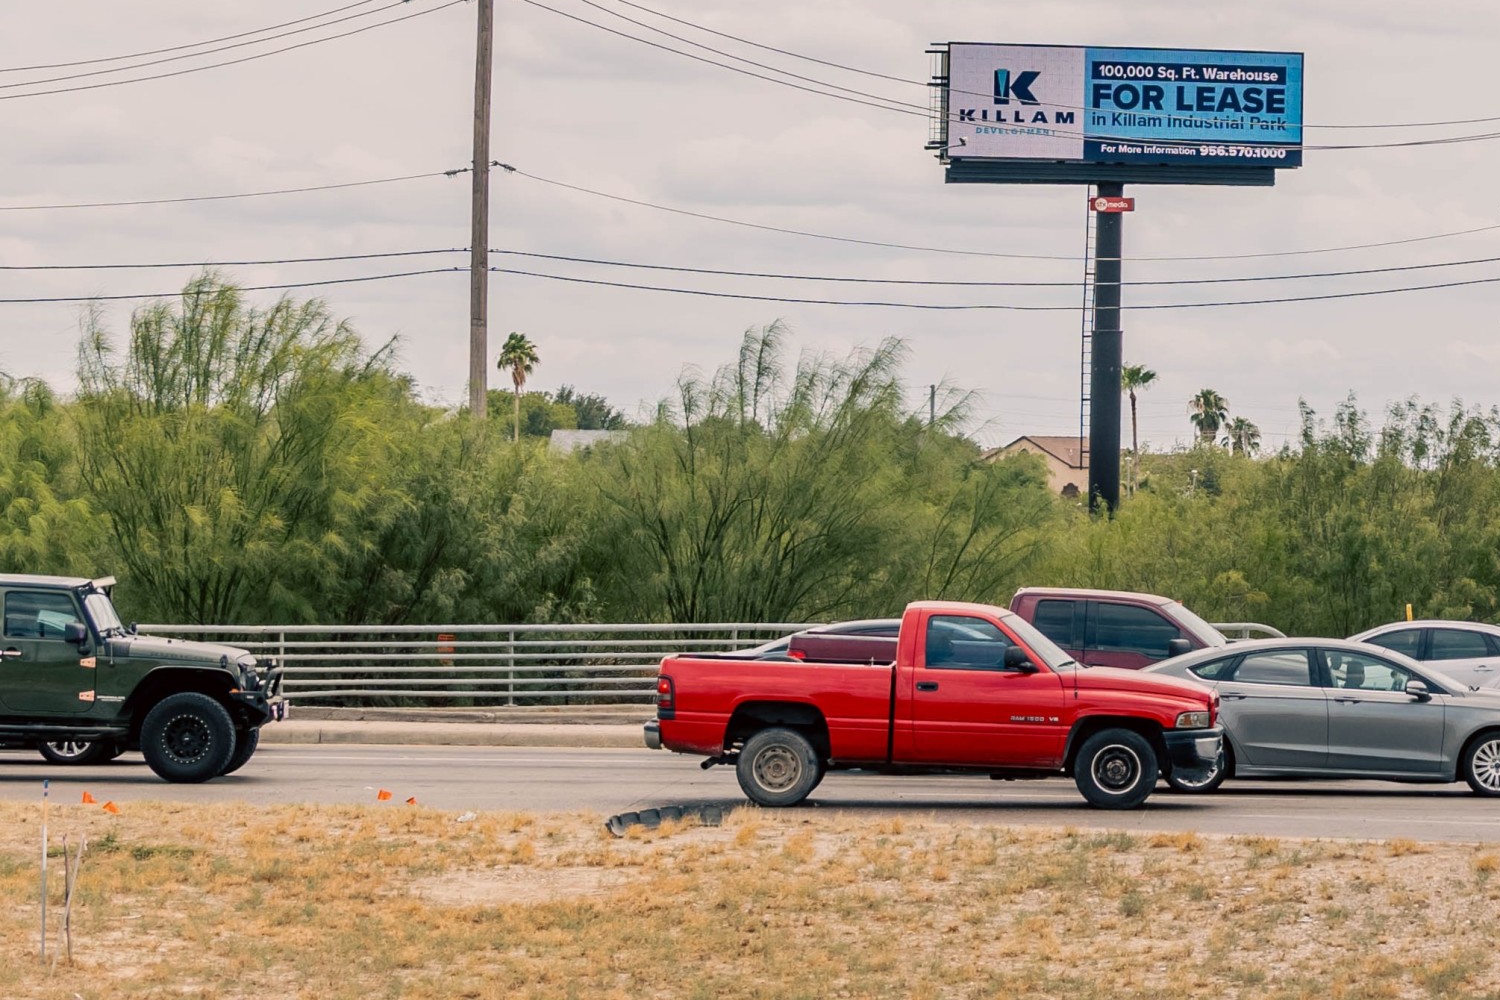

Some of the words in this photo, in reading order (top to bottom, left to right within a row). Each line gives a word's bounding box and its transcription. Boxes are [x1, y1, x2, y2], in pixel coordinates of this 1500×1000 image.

[1099, 65, 1154, 79] 100,000
[1157, 66, 1179, 81] Sq.
[1182, 67, 1200, 79] Ft.
[1202, 68, 1279, 82] Warehouse
[1092, 83, 1165, 111] FOR
[1175, 85, 1286, 114] LEASE
[959, 108, 1075, 125] KILLAM
[1092, 112, 1106, 126] in
[1111, 112, 1162, 128] Killam
[1249, 117, 1287, 131] Park
[1100, 144, 1117, 153] For
[1118, 145, 1142, 154] More
[1144, 146, 1197, 156] Information
[1200, 145, 1287, 159] 956.570.1000
